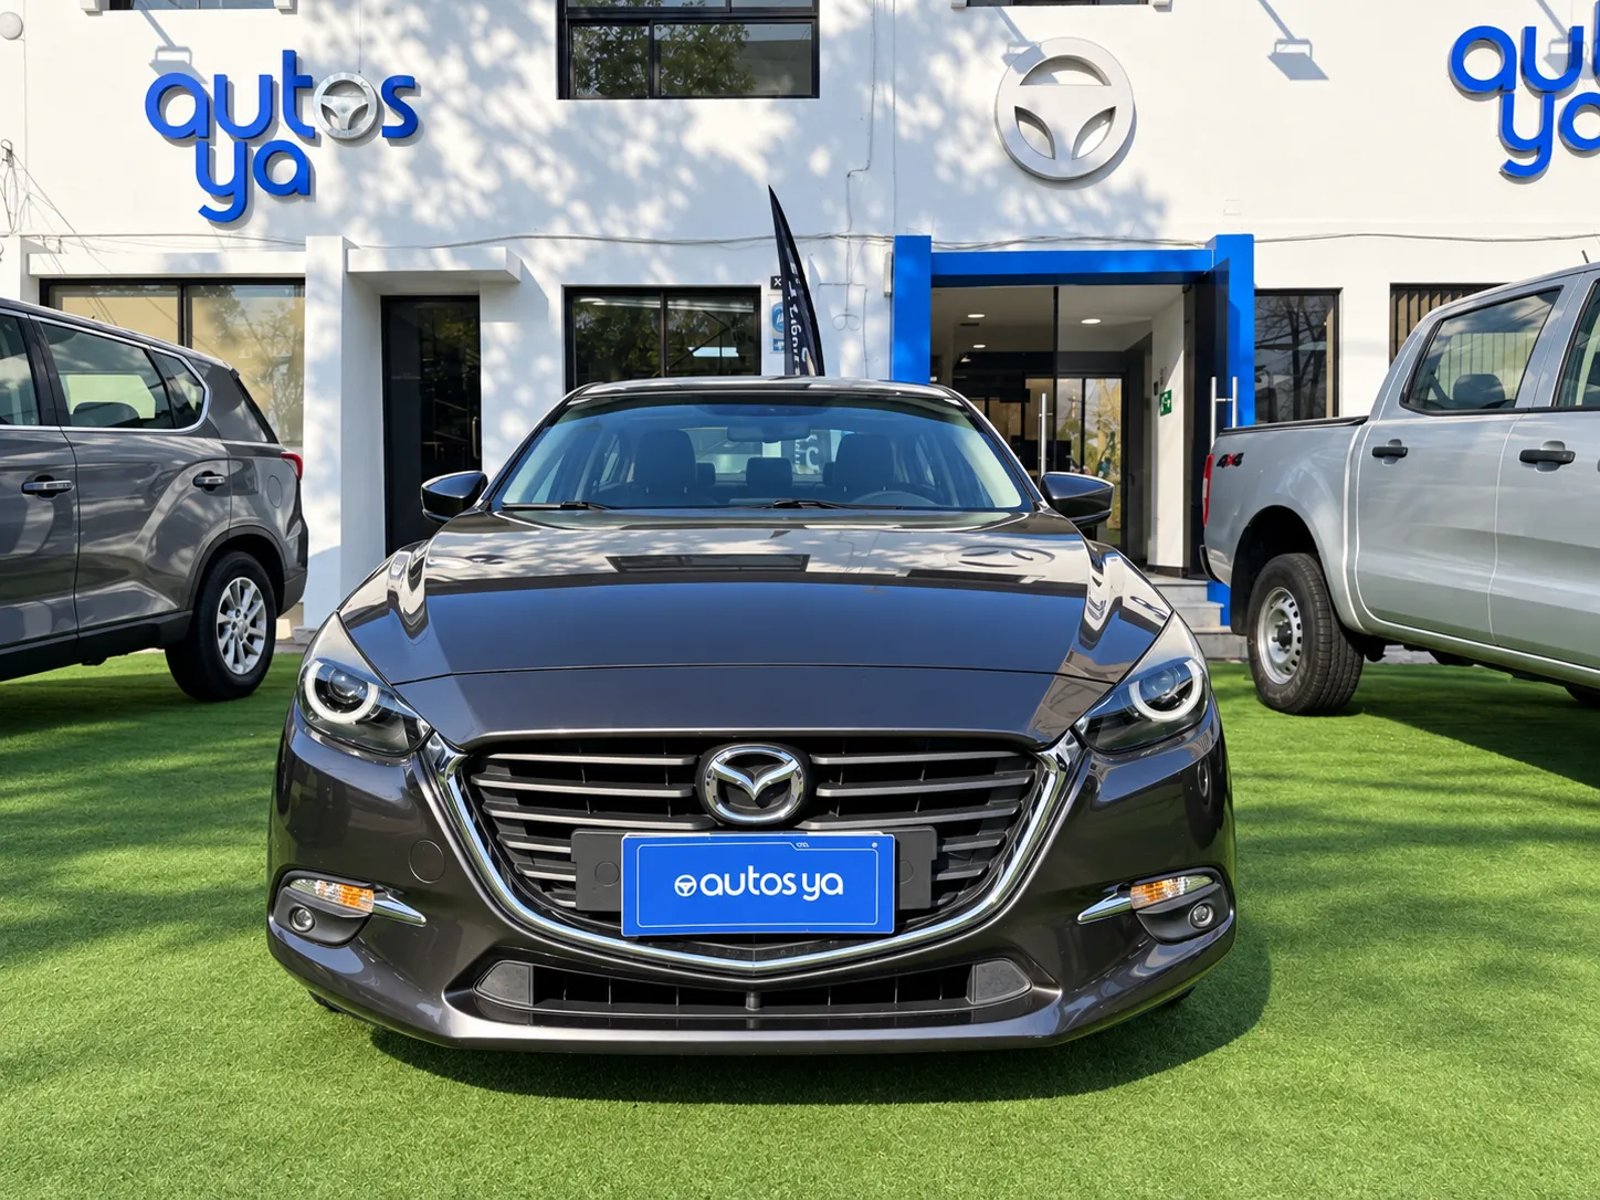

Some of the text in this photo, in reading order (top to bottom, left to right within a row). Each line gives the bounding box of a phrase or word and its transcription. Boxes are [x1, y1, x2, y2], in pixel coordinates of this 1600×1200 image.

[1449, 1, 1600, 93] au
[145, 49, 419, 140] autos
[195, 139, 311, 223] ya
[700, 865, 844, 902] autos ya
